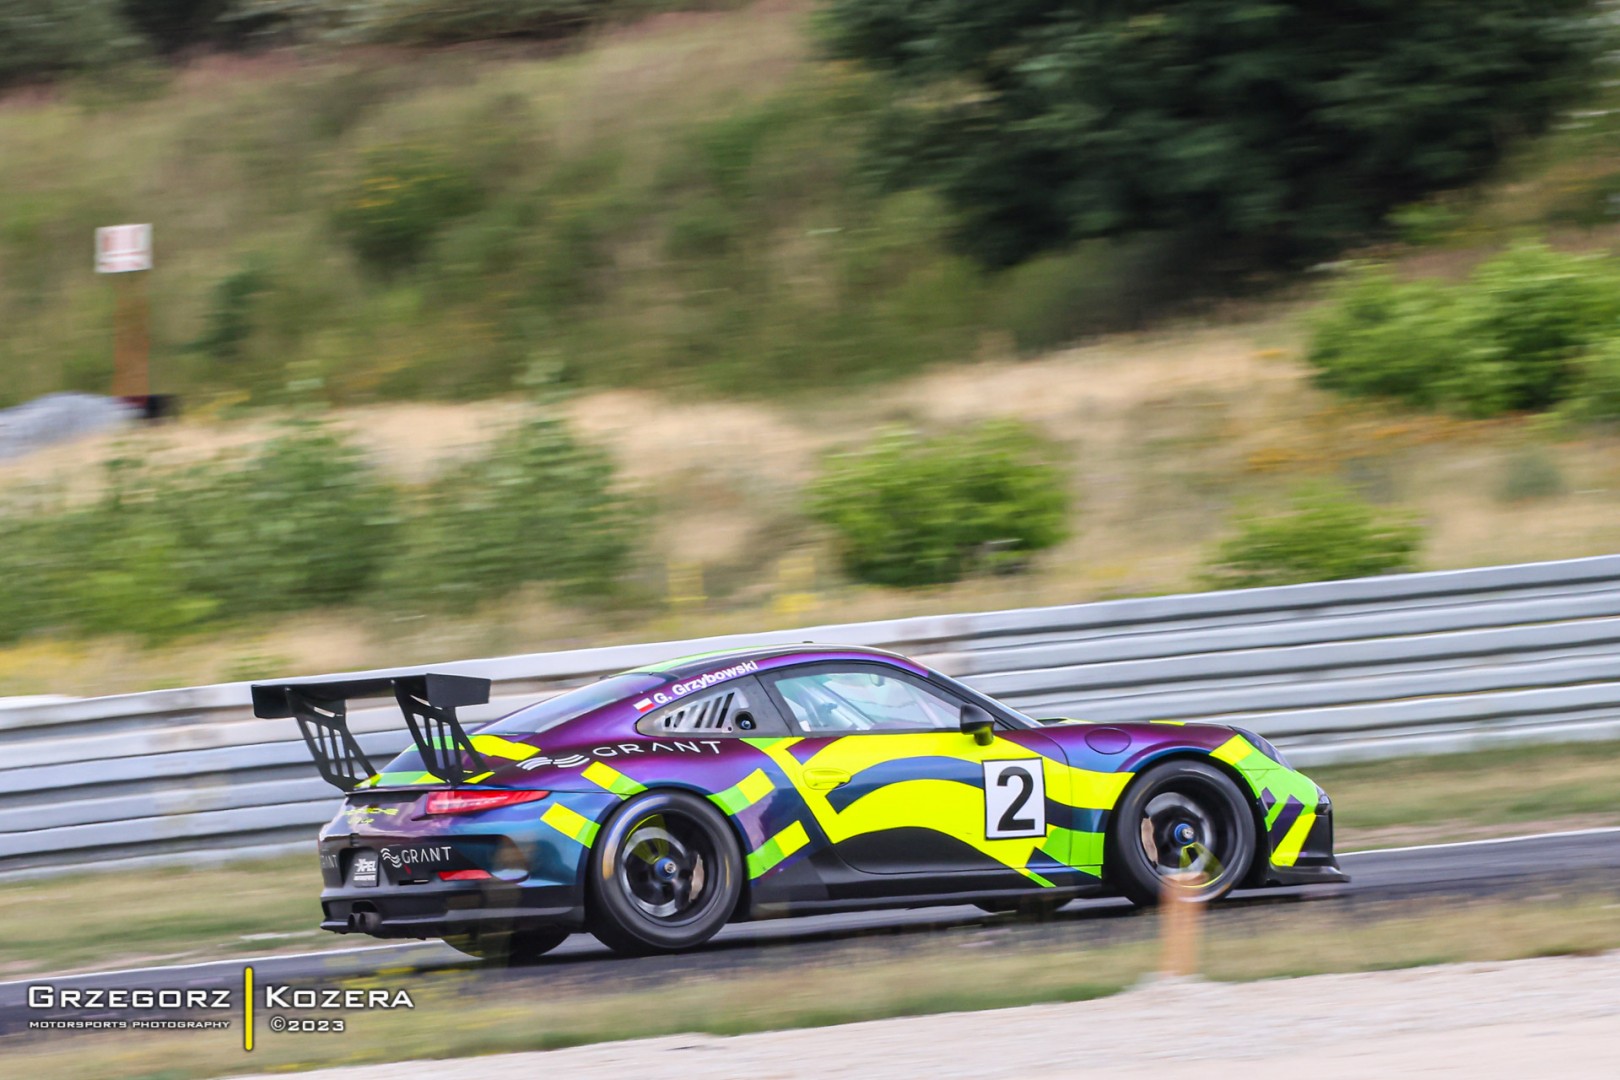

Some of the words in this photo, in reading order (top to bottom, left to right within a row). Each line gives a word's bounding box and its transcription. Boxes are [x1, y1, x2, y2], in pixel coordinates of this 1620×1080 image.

[653, 692, 673, 704] G.
[672, 660, 758, 696] Grzybowski
[592, 740, 721, 757] GRANT
[996, 766, 1036, 832] 2
[401, 846, 452, 864] GRANT
